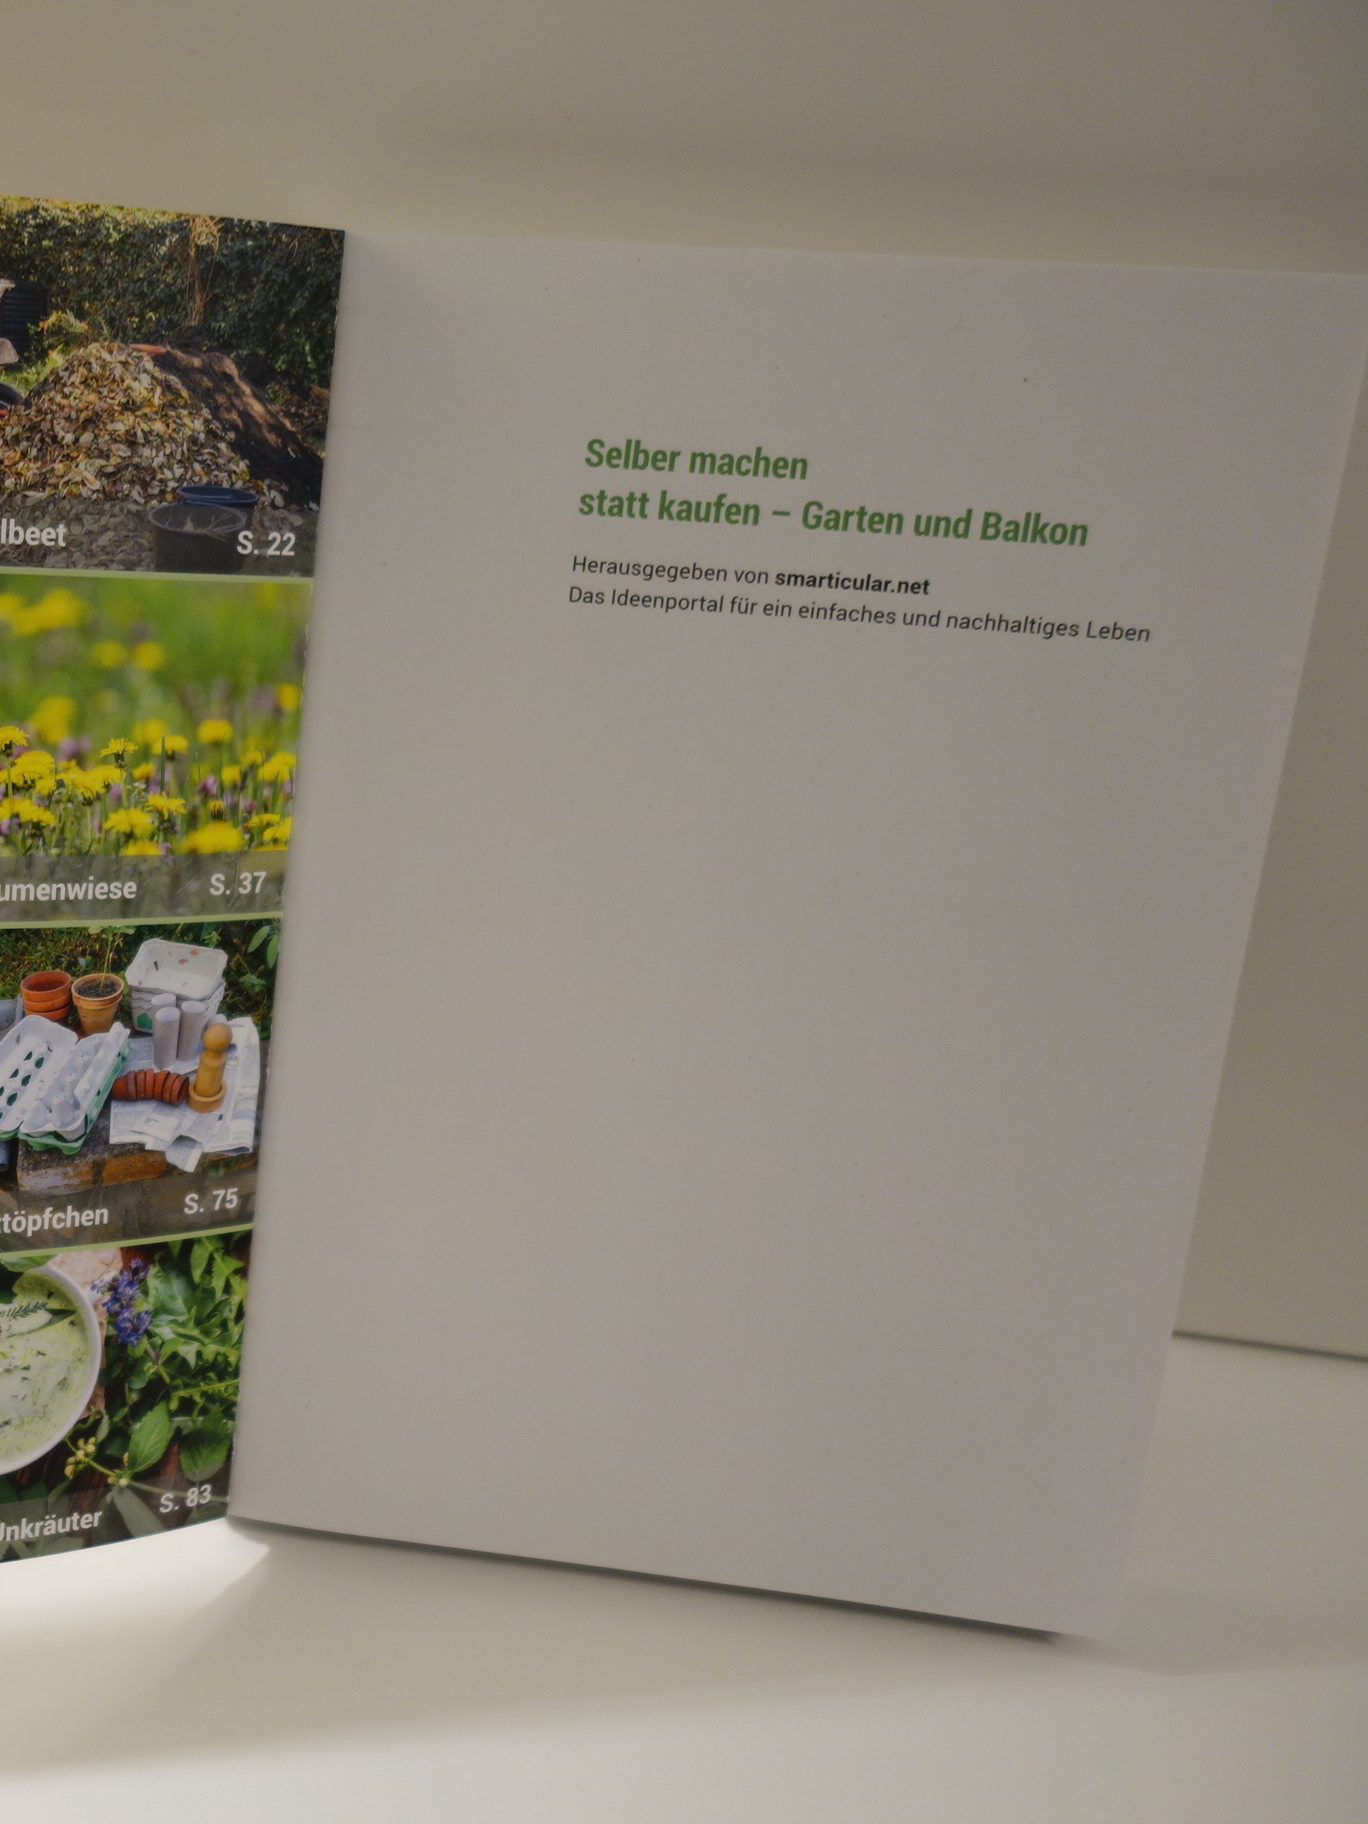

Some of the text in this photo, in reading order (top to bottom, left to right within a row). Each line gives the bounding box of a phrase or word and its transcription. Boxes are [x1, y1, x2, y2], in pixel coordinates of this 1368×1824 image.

[585, 438, 808, 480] Selber machen
[579, 489, 648, 520] statt
[657, 491, 760, 526] kaufen
[801, 500, 904, 535] Garten
[913, 509, 972, 540] und
[980, 512, 1089, 546] Balkon
[237, 530, 296, 557] S. 22
[572, 556, 930, 595] Herausgegeben von smarticular.net
[568, 586, 1151, 642] Das Ideenportal für ein einfaches und nachhaltiges Leben
[209, 871, 267, 896] S. 37
[184, 1187, 239, 1215] S. 75
[158, 1484, 212, 1514] S. 83
